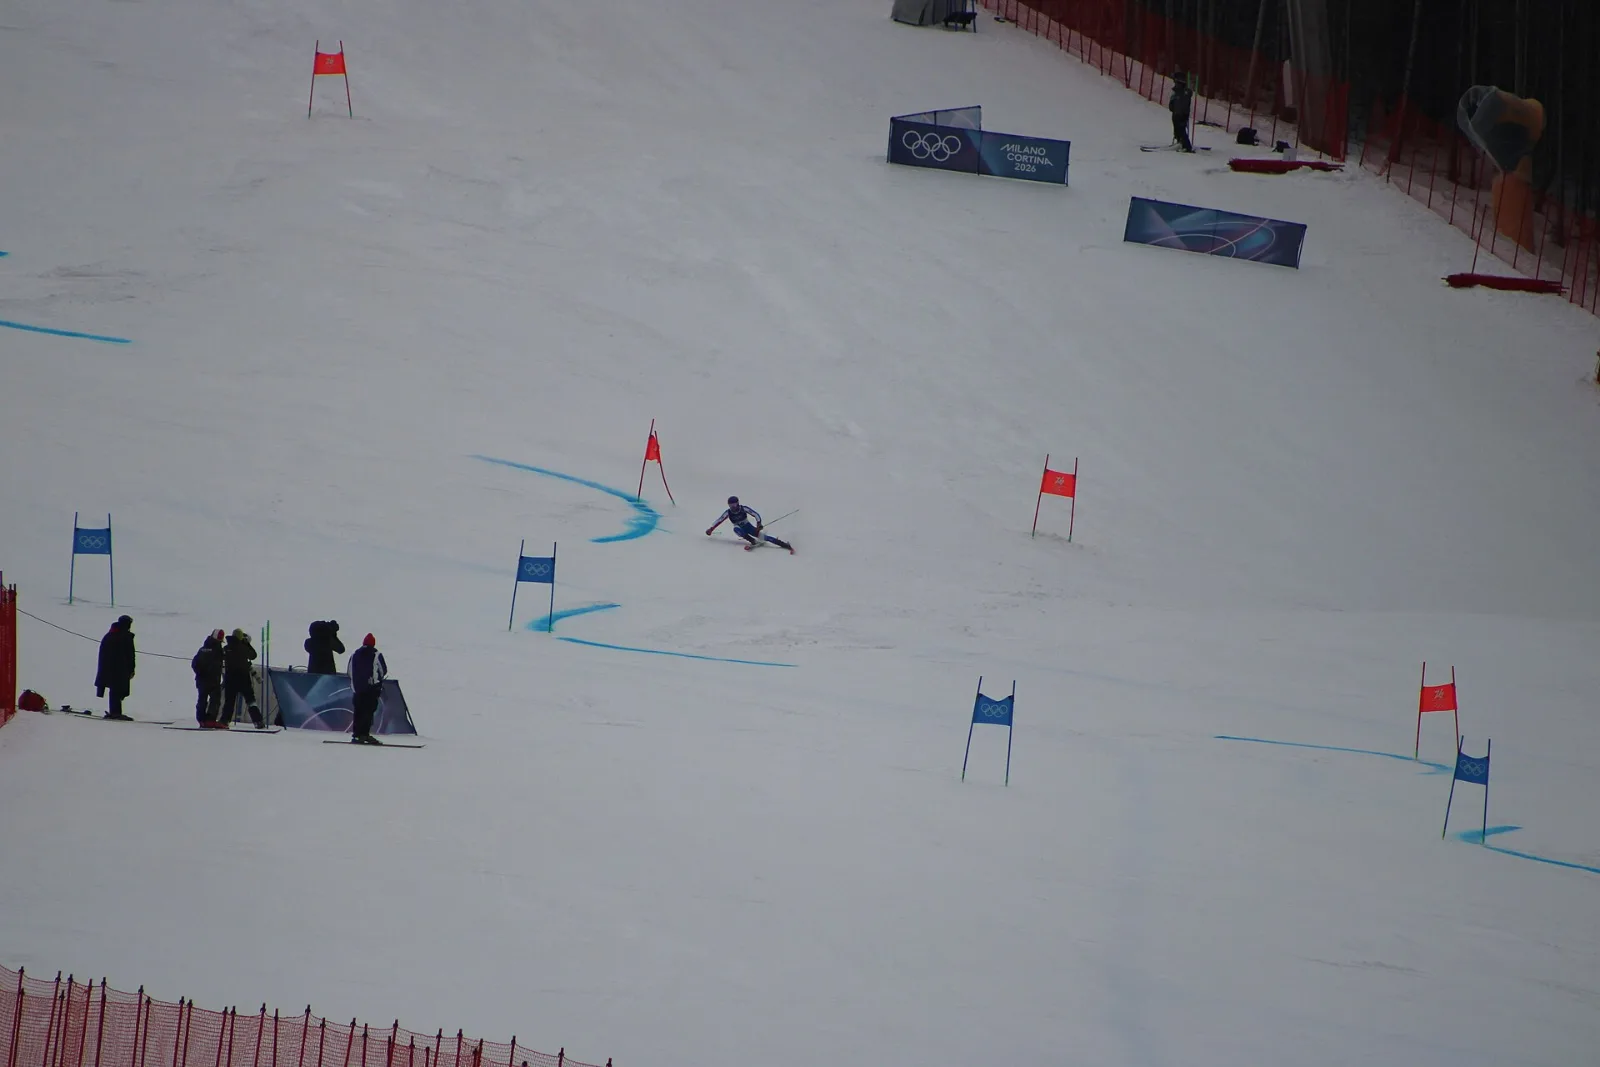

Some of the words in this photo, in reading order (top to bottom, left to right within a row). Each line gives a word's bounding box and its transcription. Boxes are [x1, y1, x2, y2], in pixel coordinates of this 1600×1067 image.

[1000, 143, 1046, 156] MILANO
[1006, 152, 1053, 166] CORTINA
[1014, 162, 1037, 173] 2026
